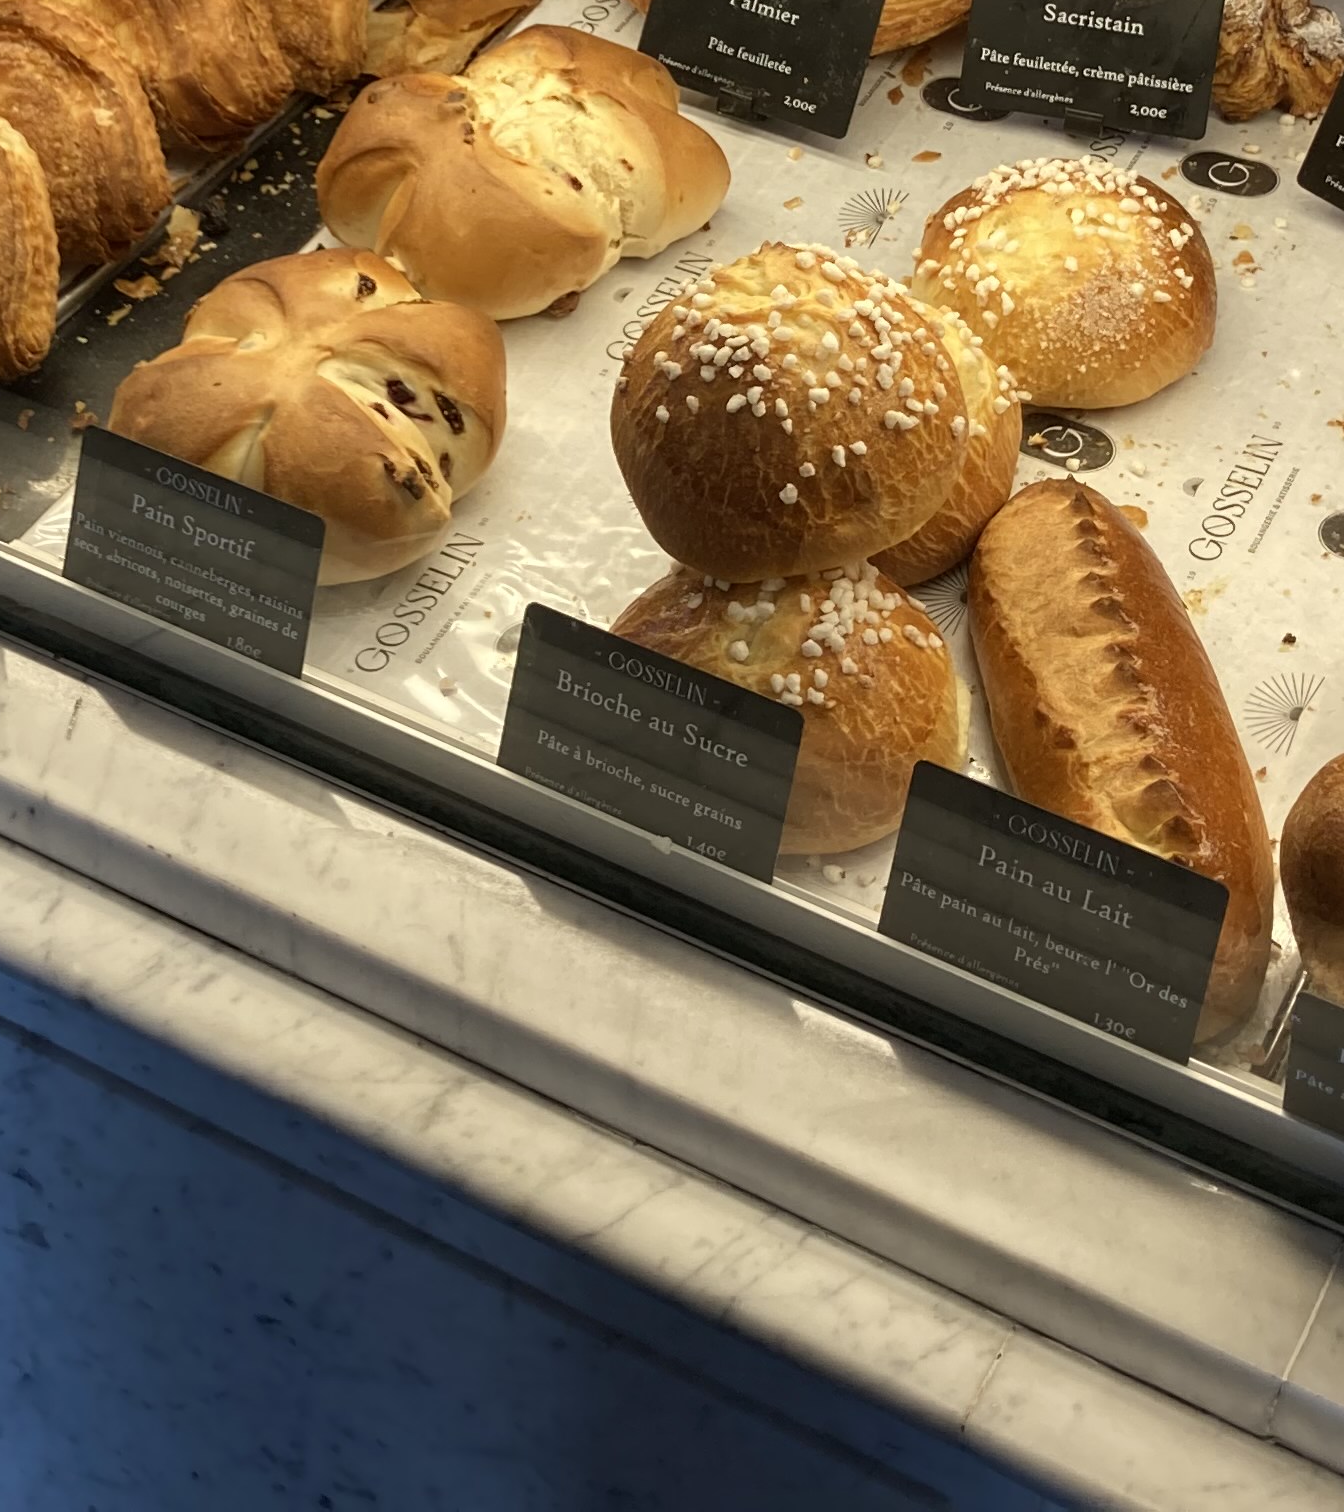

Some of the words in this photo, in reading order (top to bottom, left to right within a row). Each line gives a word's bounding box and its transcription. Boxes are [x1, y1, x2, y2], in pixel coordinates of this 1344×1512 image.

[1043, 3, 1145, 37] Sacristain
[658, 53, 691, 72] Présence
[707, 36, 734, 56] Pâte
[736, 46, 793, 75] feuilletée
[980, 48, 1010, 65] Pâte
[1013, 52, 1080, 78] feuilettée,
[1082, 65, 1125, 84] crème
[1127, 71, 1194, 94] pâtissière
[783, 95, 817, 114] 2,00€
[985, 81, 1021, 96] Présence
[1023, 87, 1074, 105] d'allergènes
[1129, 104, 1168, 120] 2,00€
[156, 467, 243, 515] GOSSELIN
[1188, 433, 1285, 561] GOSSELIN
[132, 493, 176, 530] Pain
[181, 514, 256, 561] Sportif
[73, 537, 103, 558] secs,
[105, 549, 160, 582] abricots,
[164, 574, 227, 613] noisettes,
[229, 602, 279, 632] graines
[282, 623, 300, 641] de
[76, 511, 104, 536] Pain
[108, 528, 167, 564] viennois,
[259, 593, 304, 620] raisins
[156, 593, 206, 623] courges
[355, 531, 485, 673] GOSSELIN
[608, 650, 708, 706] GOSSELIN
[556, 669, 643, 724] Brioche
[648, 715, 675, 737] au
[682, 722, 750, 768] Sucre
[537, 729, 570, 757] Pâte
[572, 743, 582, 761] à
[586, 749, 645, 791] brioche,
[650, 781, 691, 808] sucre
[693, 801, 743, 830] grains
[1008, 814, 1120, 876] GOSSELIN
[977, 843, 1035, 888] Pain
[1040, 878, 1072, 905] au
[1080, 889, 1135, 929] Lait
[901, 870, 937, 900] Pâte
[939, 891, 977, 917] pain
[981, 909, 1003, 929] au
[1007, 916, 1041, 947] lait,
[1158, 984, 1189, 1010] des
[1295, 1067, 1335, 1097] Pâte
